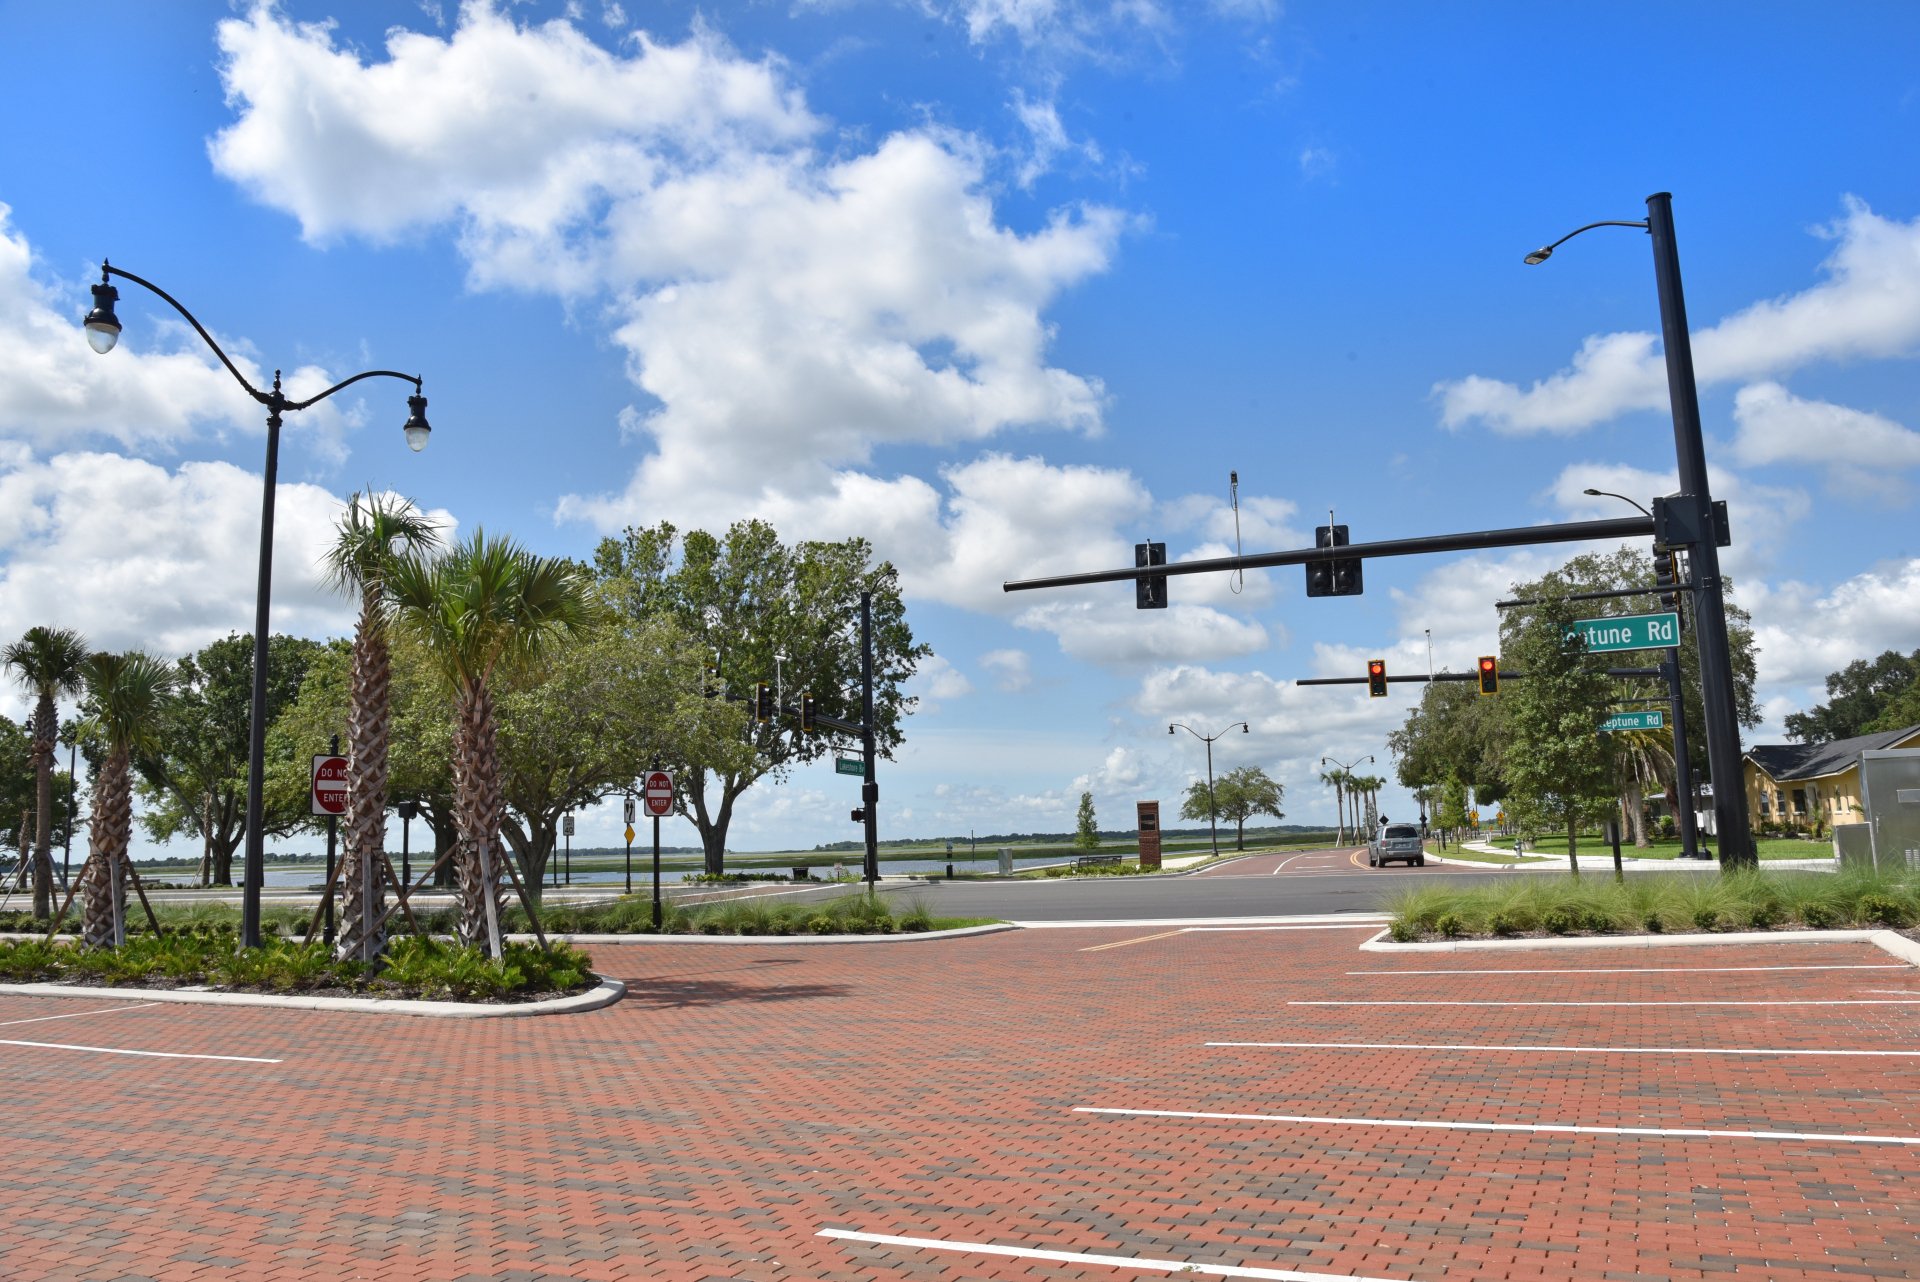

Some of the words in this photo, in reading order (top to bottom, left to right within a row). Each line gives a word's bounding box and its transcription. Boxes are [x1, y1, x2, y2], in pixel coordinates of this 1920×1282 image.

[1561, 626, 1632, 650] eptune
[1647, 621, 1672, 641] Rd
[1600, 716, 1639, 729] eptune
[1646, 715, 1659, 725] Rd
[321, 768, 333, 777] DO
[336, 768, 348, 777] NO
[649, 780, 657, 788] DO
[659, 780, 669, 788] NOT
[651, 799, 667, 807] ENTER
[564, 826, 573, 834] 40
